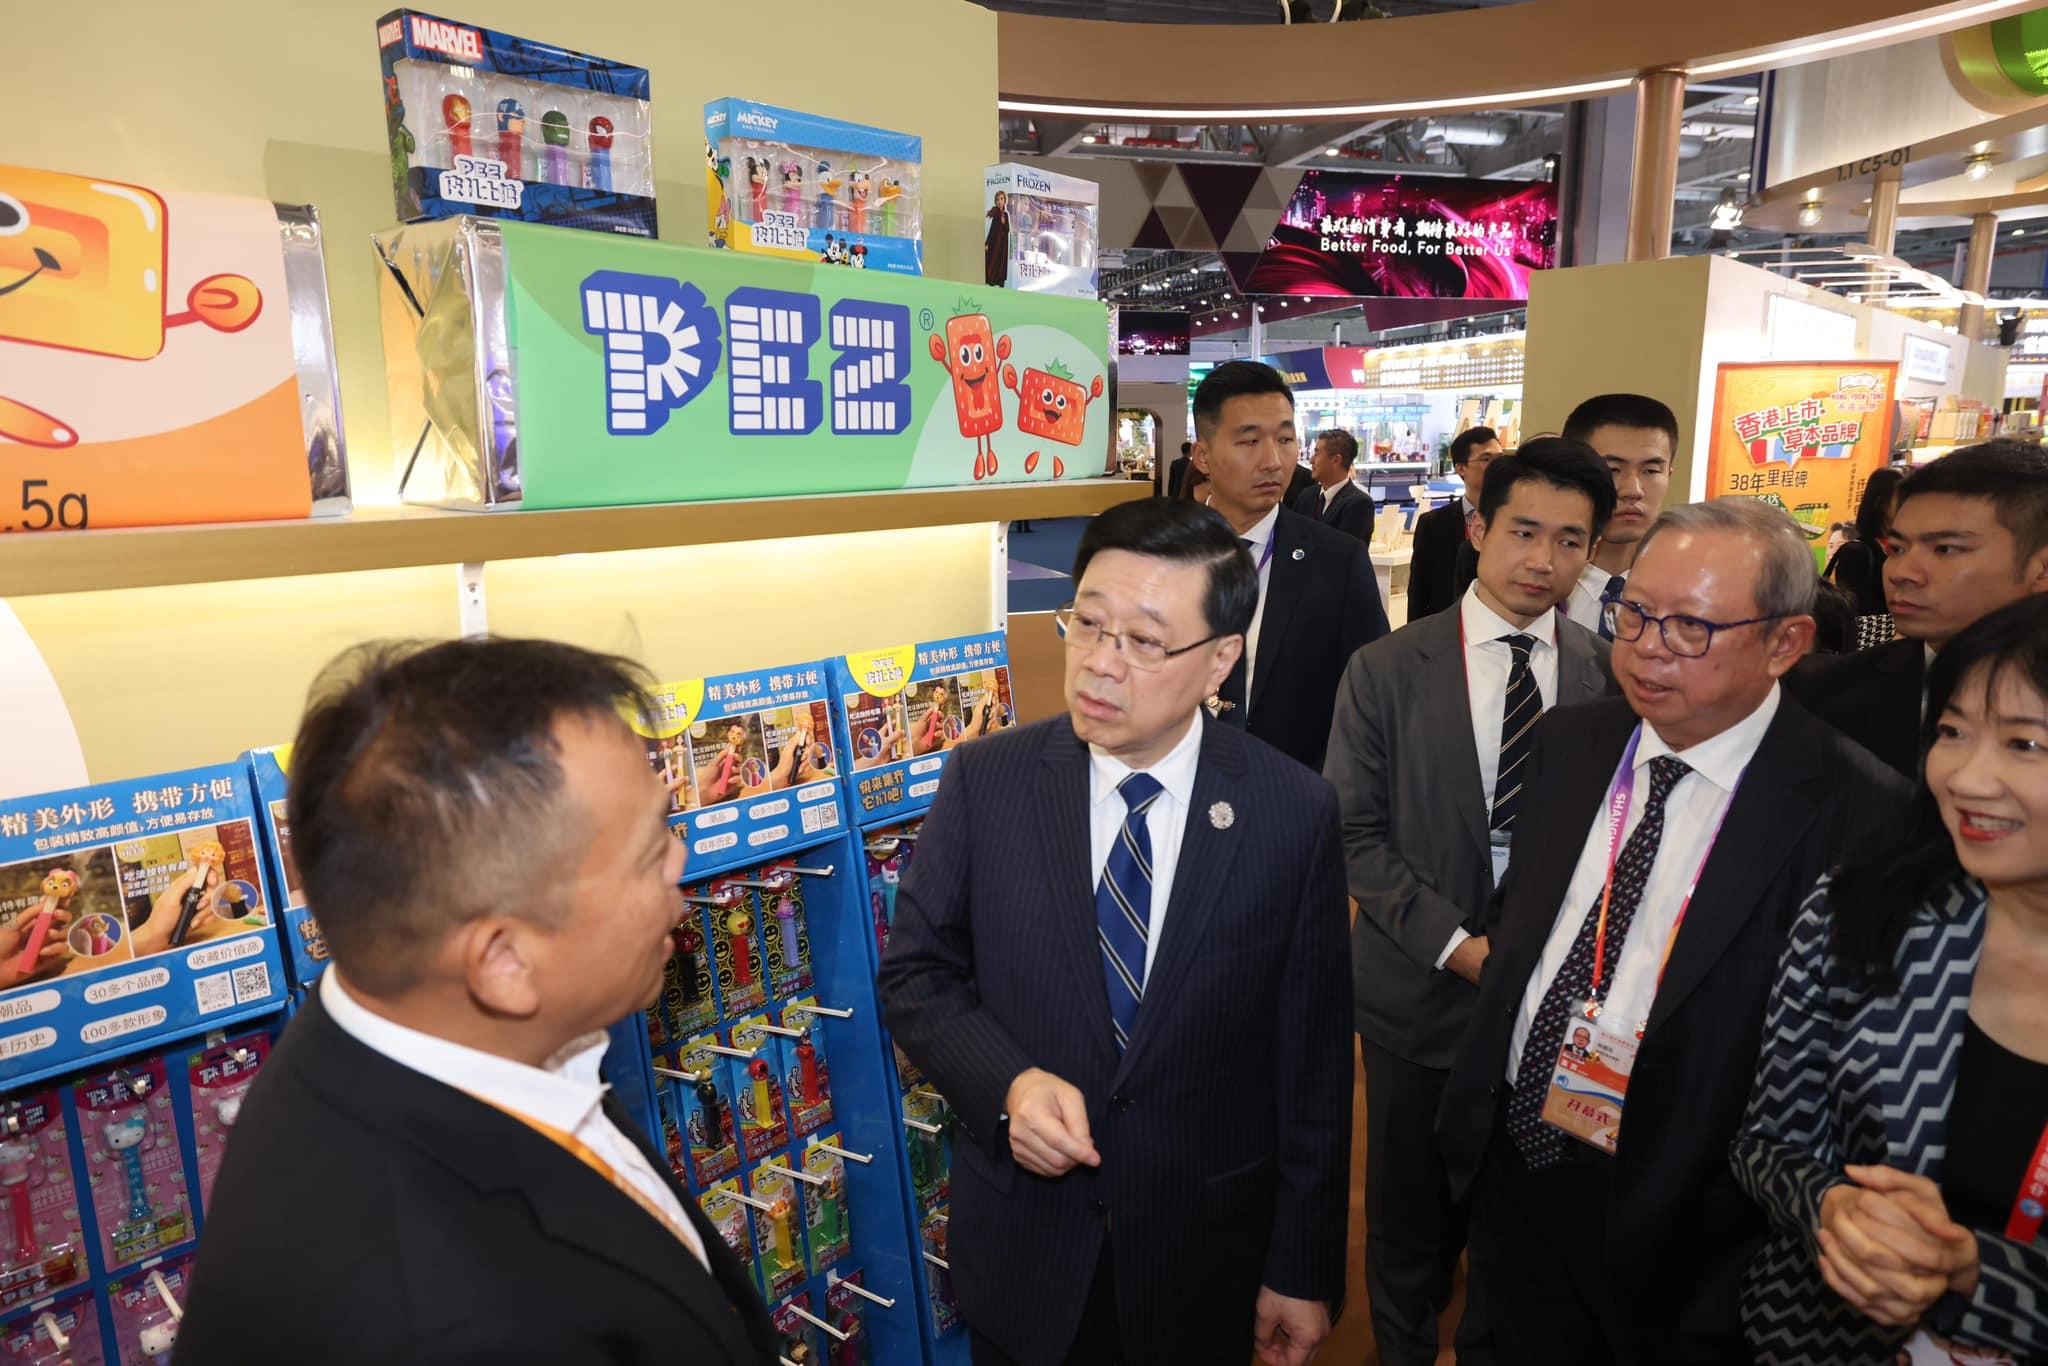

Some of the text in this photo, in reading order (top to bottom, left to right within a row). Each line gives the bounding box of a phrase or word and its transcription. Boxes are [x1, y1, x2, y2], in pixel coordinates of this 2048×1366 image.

[379, 19, 402, 47] MARVEL
[411, 17, 482, 60] MARVEL
[737, 112, 778, 128] MICKEY
[459, 158, 501, 180] PEZ
[1836, 146, 1911, 182] 1.1 C5-01
[986, 176, 1010, 187] FROZEN
[1017, 174, 1051, 193] FROZEN
[765, 212, 794, 228] PEZ
[1321, 238, 1511, 256] Better Food, For Better Us
[582, 278, 905, 432] PEZ
[1783, 422, 1858, 450] 草本品牌
[1730, 469, 1808, 493] 38年里程碑
[918, 648, 958, 666] 精美外形
[963, 641, 1001, 658] 携带方便
[708, 670, 818, 701] 精美外形 携带方便
[1, 777, 234, 838] 精美外形 携带方便
[193, 941, 260, 966] 收藏价值高
[90, 973, 165, 1001] 30多个品牌
[84, 1008, 165, 1042] 100多款形象
[1567, 1098, 1611, 1125] 开幕式
